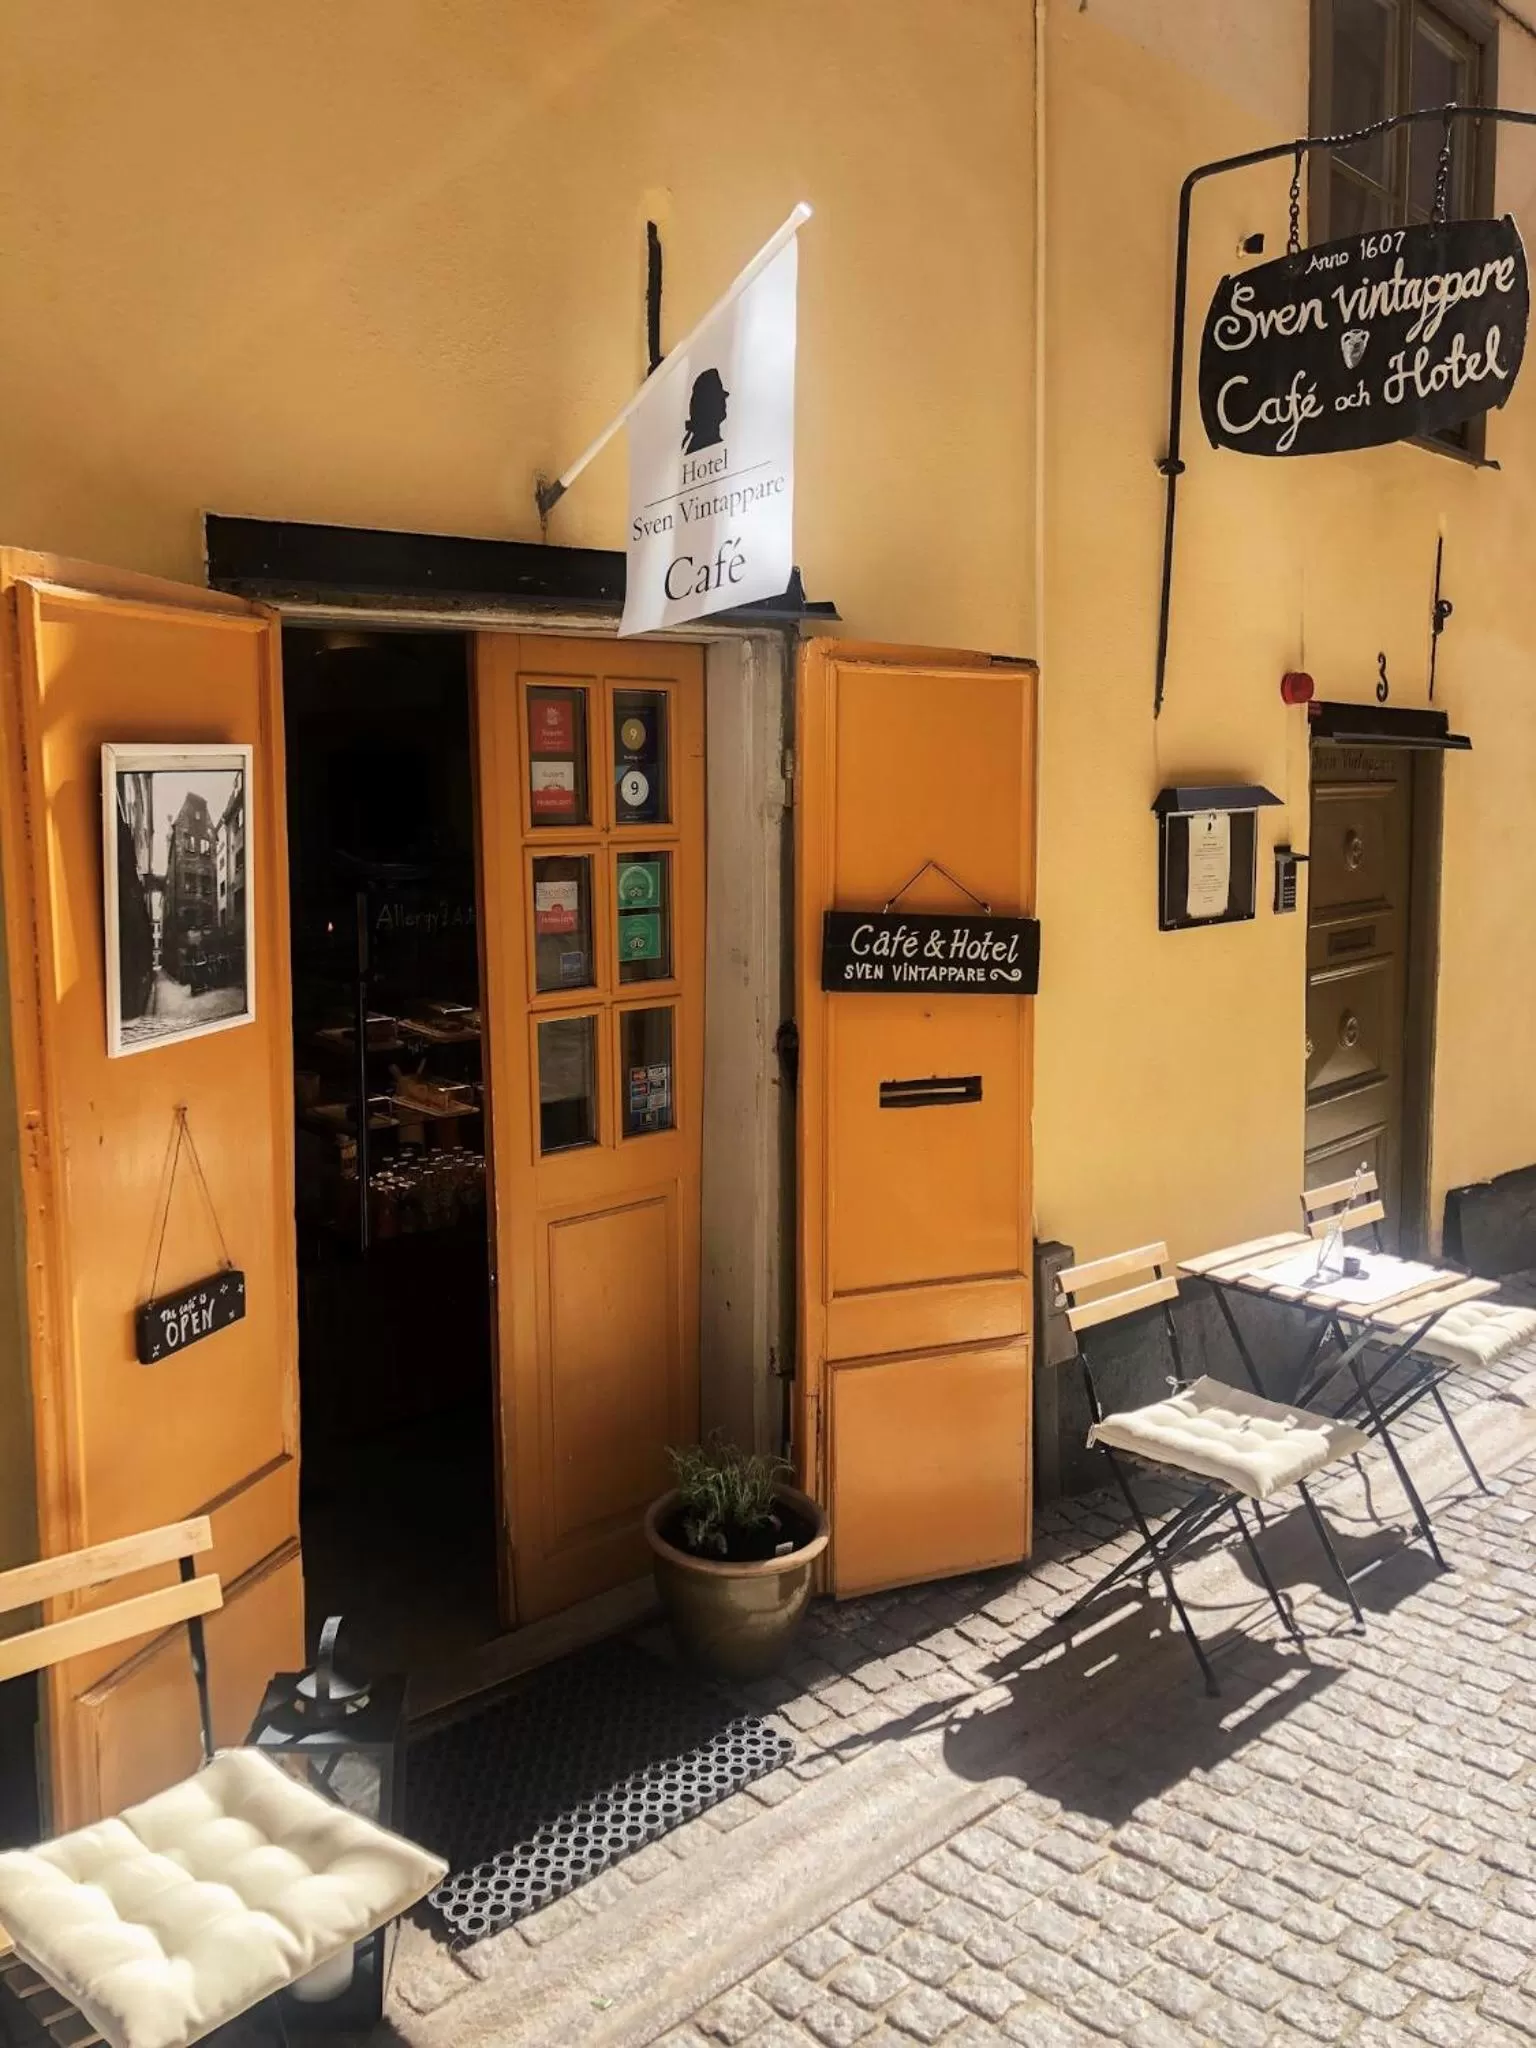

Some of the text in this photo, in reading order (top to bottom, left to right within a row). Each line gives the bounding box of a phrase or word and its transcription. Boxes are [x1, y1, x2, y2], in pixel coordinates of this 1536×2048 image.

[1305, 231, 1406, 275] Anno 1607
[1214, 282, 1327, 351] Sven
[1217, 325, 1508, 452] Café och Hotel
[683, 449, 728, 485] Hotel
[632, 476, 785, 541] Sven Vintappare
[664, 537, 746, 600] Café
[1376, 652, 1389, 702] 3
[629, 728, 638, 741] 9
[630, 781, 639, 796] 9
[851, 924, 1019, 963] Café & Hotel
[844, 962, 883, 980] SVEN
[166, 1298, 215, 1347] OPEN
